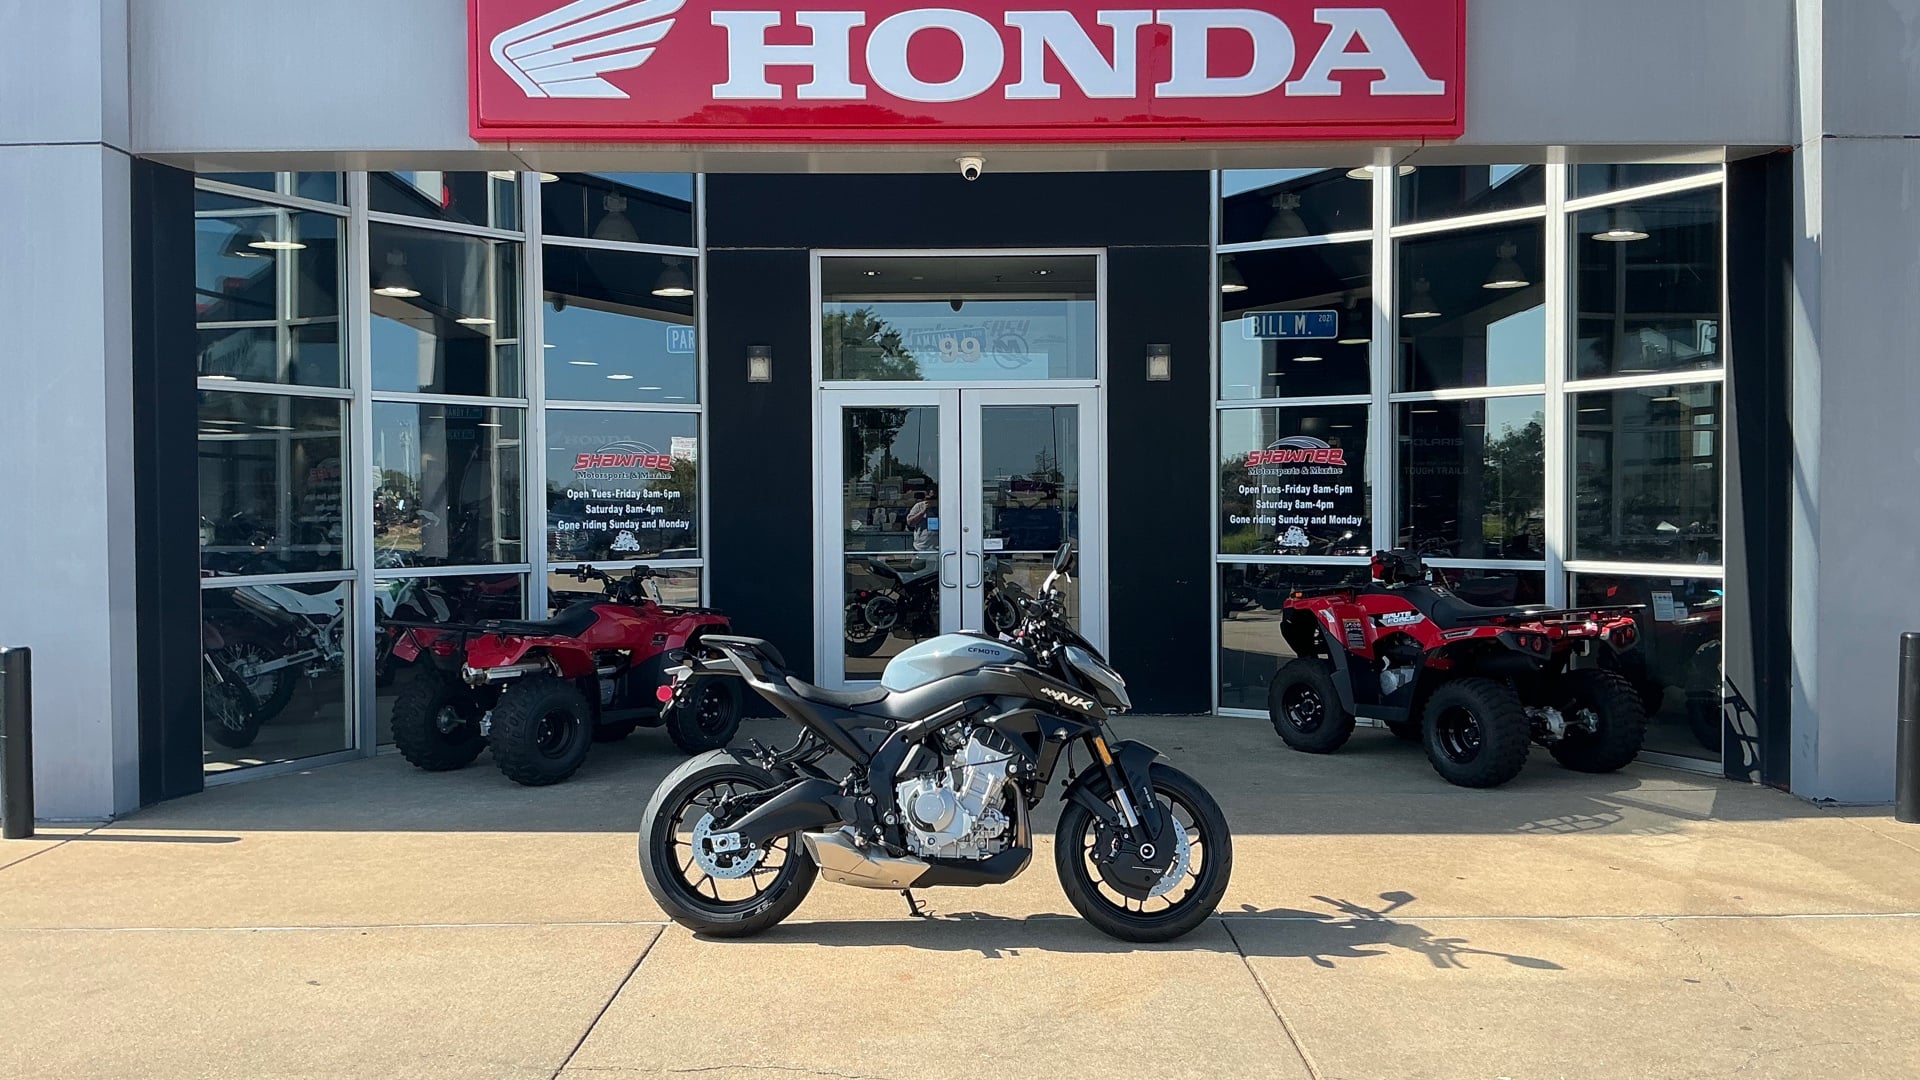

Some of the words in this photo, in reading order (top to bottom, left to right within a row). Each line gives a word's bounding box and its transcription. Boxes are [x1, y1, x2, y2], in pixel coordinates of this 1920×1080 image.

[711, 8, 1446, 102] HONDA
[1251, 315, 1287, 336] BILL
[1294, 314, 1312, 335] M.
[938, 336, 981, 363] 99
[577, 471, 629, 481] Motorsports
[630, 471, 640, 480] &
[1248, 467, 1300, 476] Motorsports
[1300, 467, 1309, 475] &
[1309, 466, 1343, 475] Marine
[567, 489, 589, 500] Open
[592, 489, 641, 500] Tues-Friday
[643, 488, 681, 500] 8am-6pm
[1238, 485, 1260, 496] Open
[1262, 484, 1311, 496] Tues-Friday
[1313, 484, 1353, 495] 8am-6pm
[585, 504, 623, 516] Saturday
[625, 504, 664, 515] 8am-4pm
[1256, 500, 1292, 511] Saturday
[1295, 499, 1334, 511] 8am-4pm
[558, 520, 580, 530] Gone
[583, 520, 607, 531] riding
[609, 520, 640, 531] Sunday
[641, 519, 657, 529] and
[658, 519, 690, 530] Monday
[1230, 514, 1250, 524] Gone
[1253, 514, 1277, 526] riding
[1278, 514, 1309, 526] Sunday
[1311, 514, 1327, 524] and
[1329, 514, 1363, 526] Monday
[1387, 615, 1417, 624] FORCE
[968, 647, 1000, 656] CFMOTO
